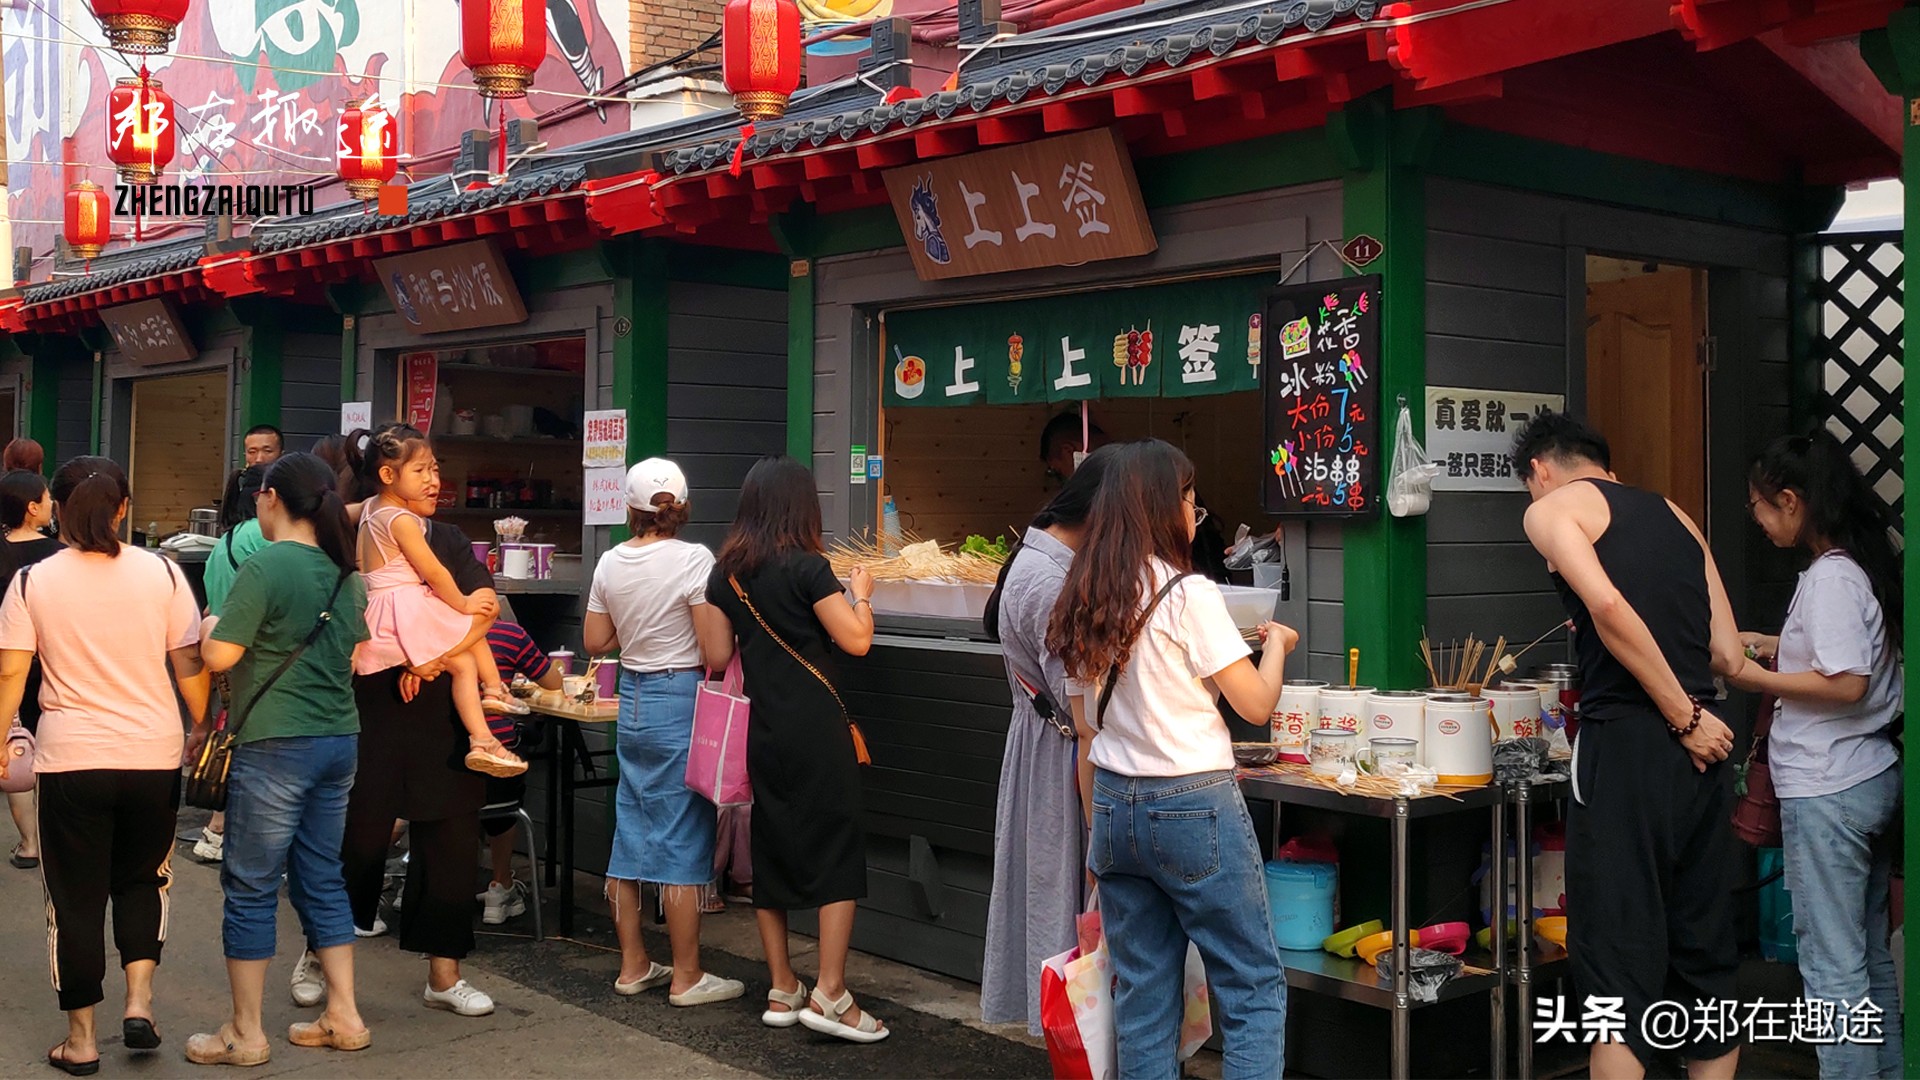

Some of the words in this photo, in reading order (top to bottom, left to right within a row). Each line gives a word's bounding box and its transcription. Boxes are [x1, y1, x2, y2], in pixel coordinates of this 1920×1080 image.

[958, 161, 1111, 250] 上上签
[1353, 244, 1371, 258] 11
[617, 322, 628, 333] 12
[1280, 361, 1337, 398] 冰粉
[1286, 388, 1367, 430] 大份7元
[1298, 423, 1369, 456] 小份5元
[1304, 452, 1361, 487] 沾串串
[1432, 452, 1515, 478] 一签只要沾
